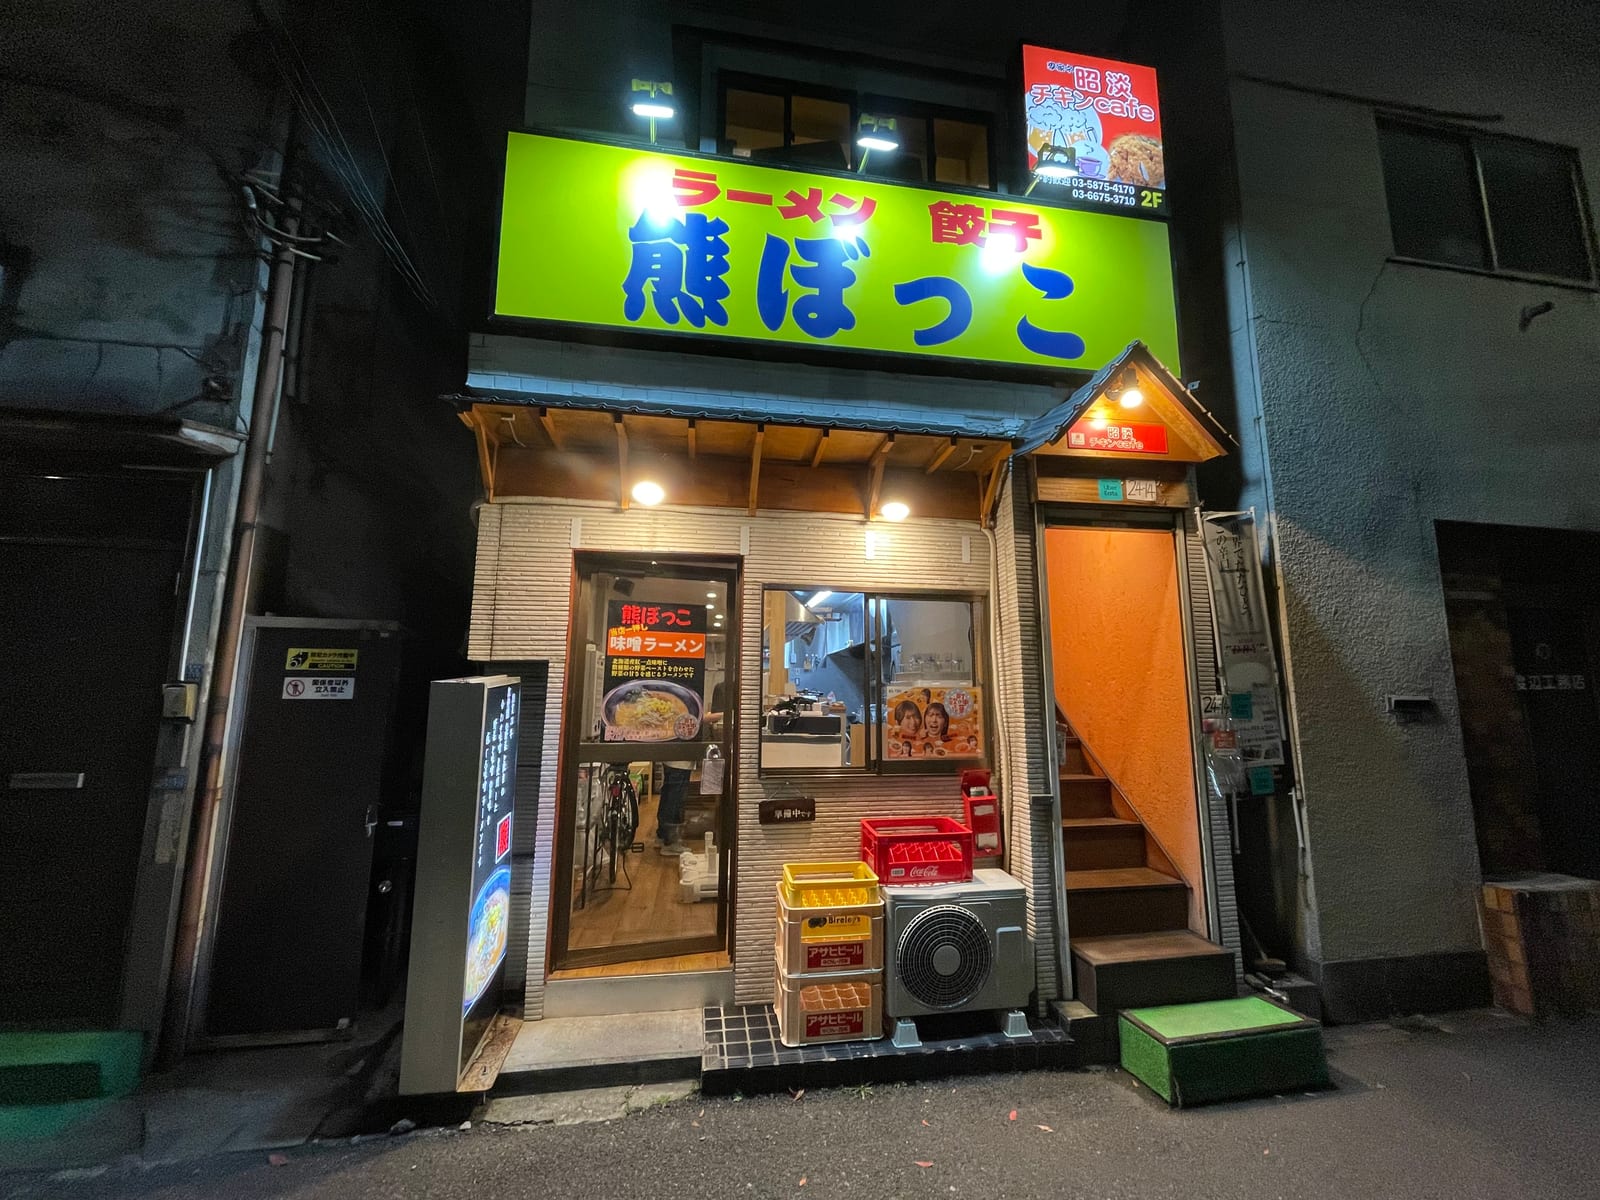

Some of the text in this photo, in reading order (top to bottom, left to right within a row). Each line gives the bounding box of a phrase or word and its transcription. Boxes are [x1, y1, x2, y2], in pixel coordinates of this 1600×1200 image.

[1072, 178, 1135, 195] 03-5875-4170
[672, 168, 877, 225] ラーメン
[1072, 189, 1136, 206] 03-6675-3710
[1140, 191, 1163, 208] 2F
[930, 199, 1043, 254] 餃子
[621, 209, 1086, 360] 熊ぼっこ
[621, 604, 692, 626] 熊ぼっこ
[610, 635, 703, 653] 味噌ラーメン
[808, 945, 862, 958] アサヒビール
[807, 1012, 862, 1027] アサヒビール
